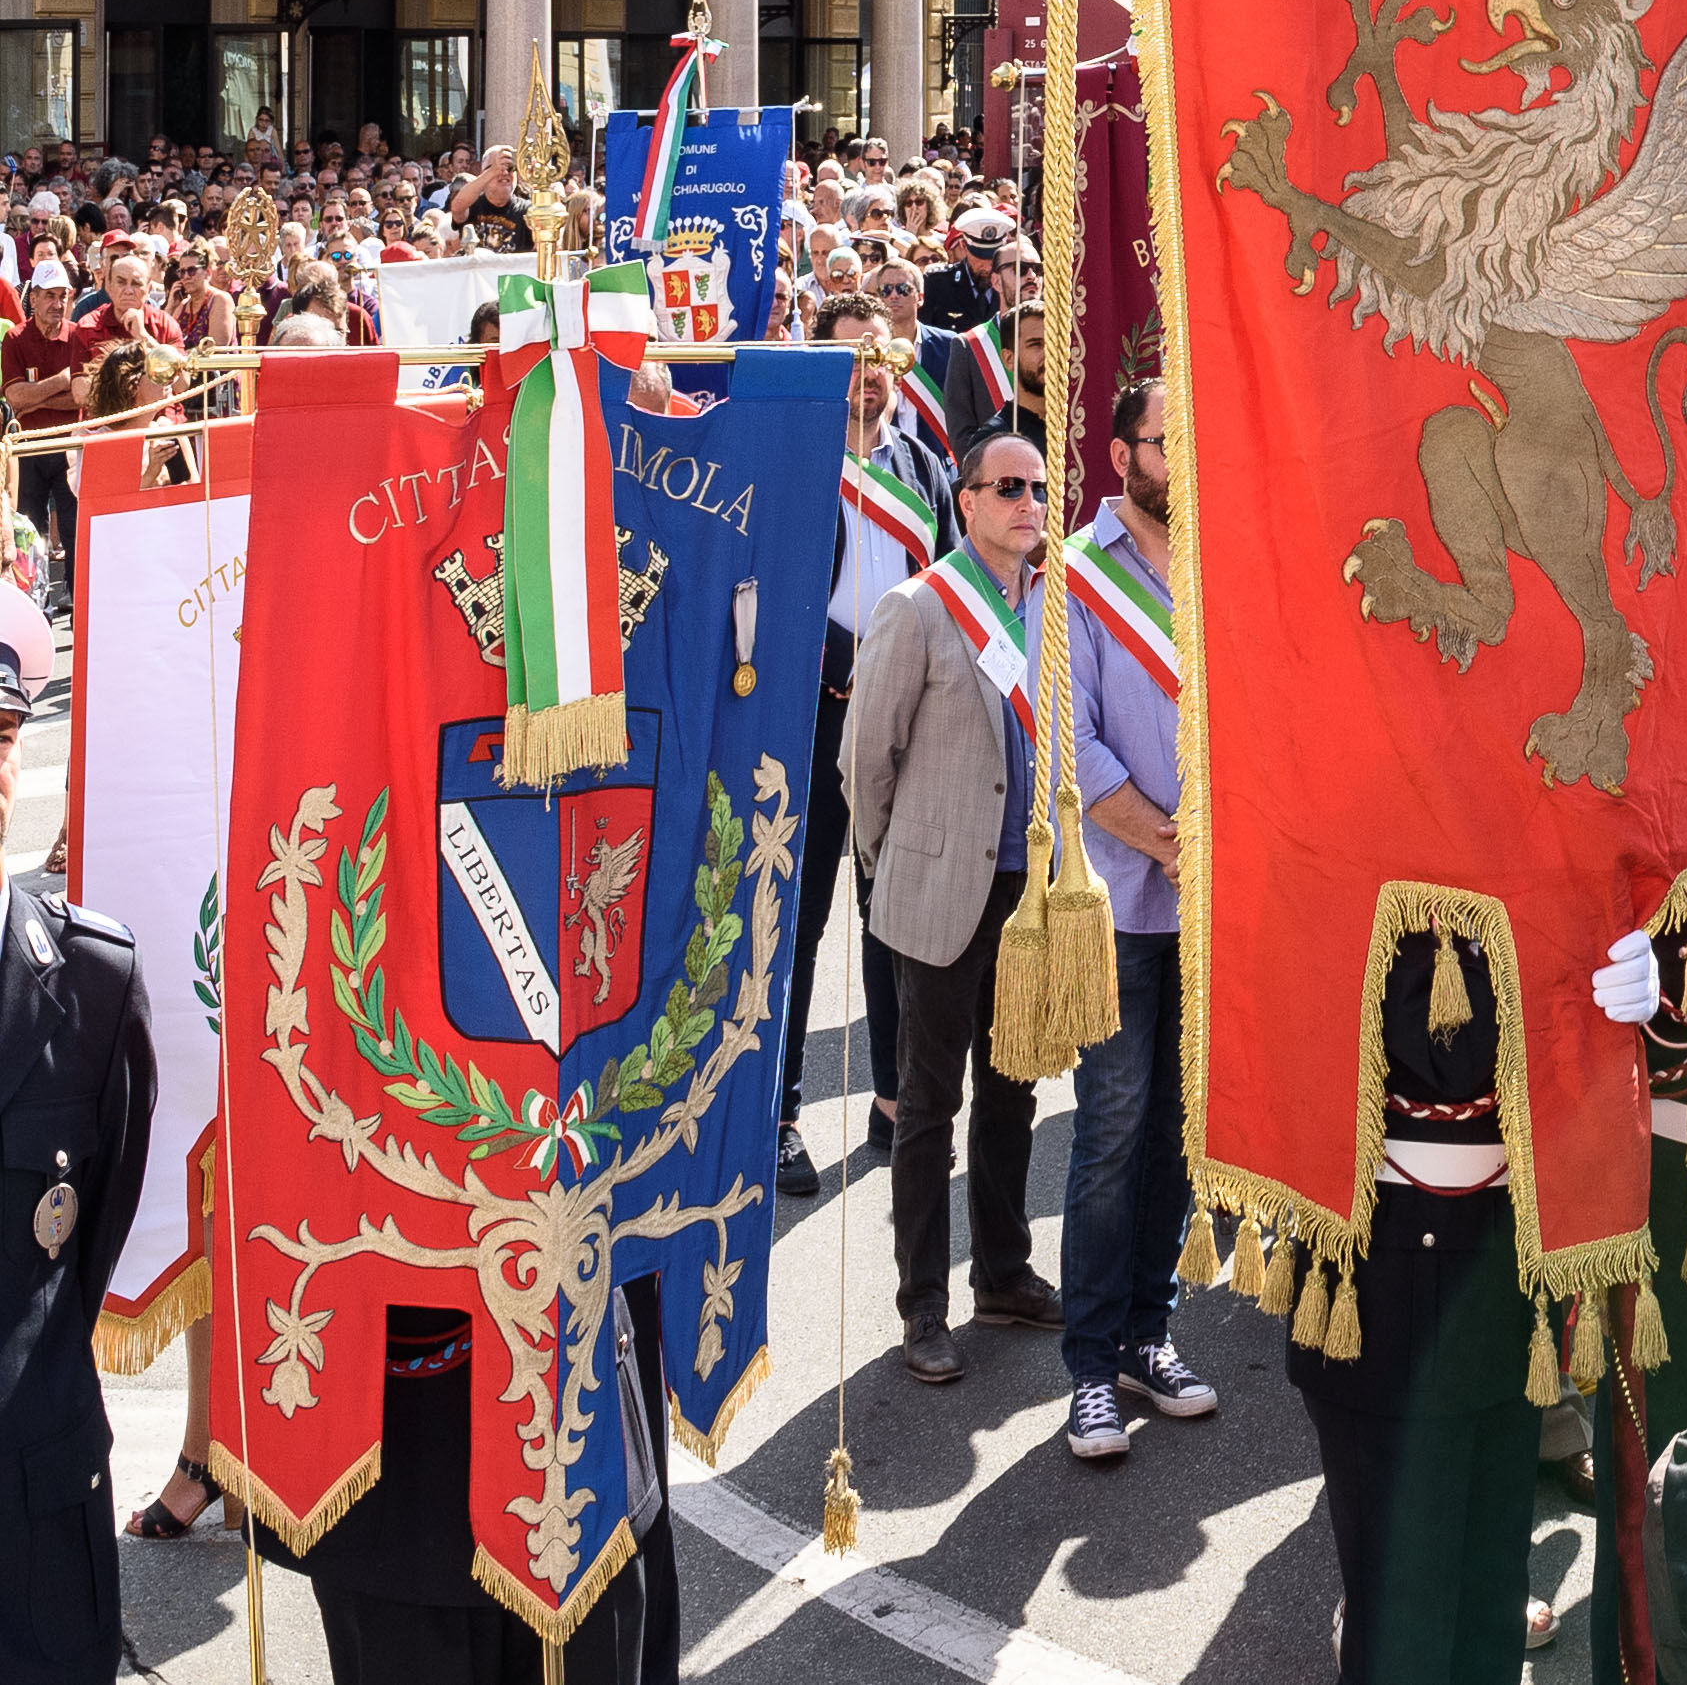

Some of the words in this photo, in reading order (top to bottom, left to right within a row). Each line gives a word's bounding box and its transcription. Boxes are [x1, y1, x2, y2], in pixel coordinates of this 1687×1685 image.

[679, 143, 718, 156] OMUNE
[685, 165, 698, 175] DI
[632, 182, 746, 204] MCHIARUGOLO
[614, 423, 759, 537] IMOLA
[445, 822, 551, 1016] LIBERTAS
